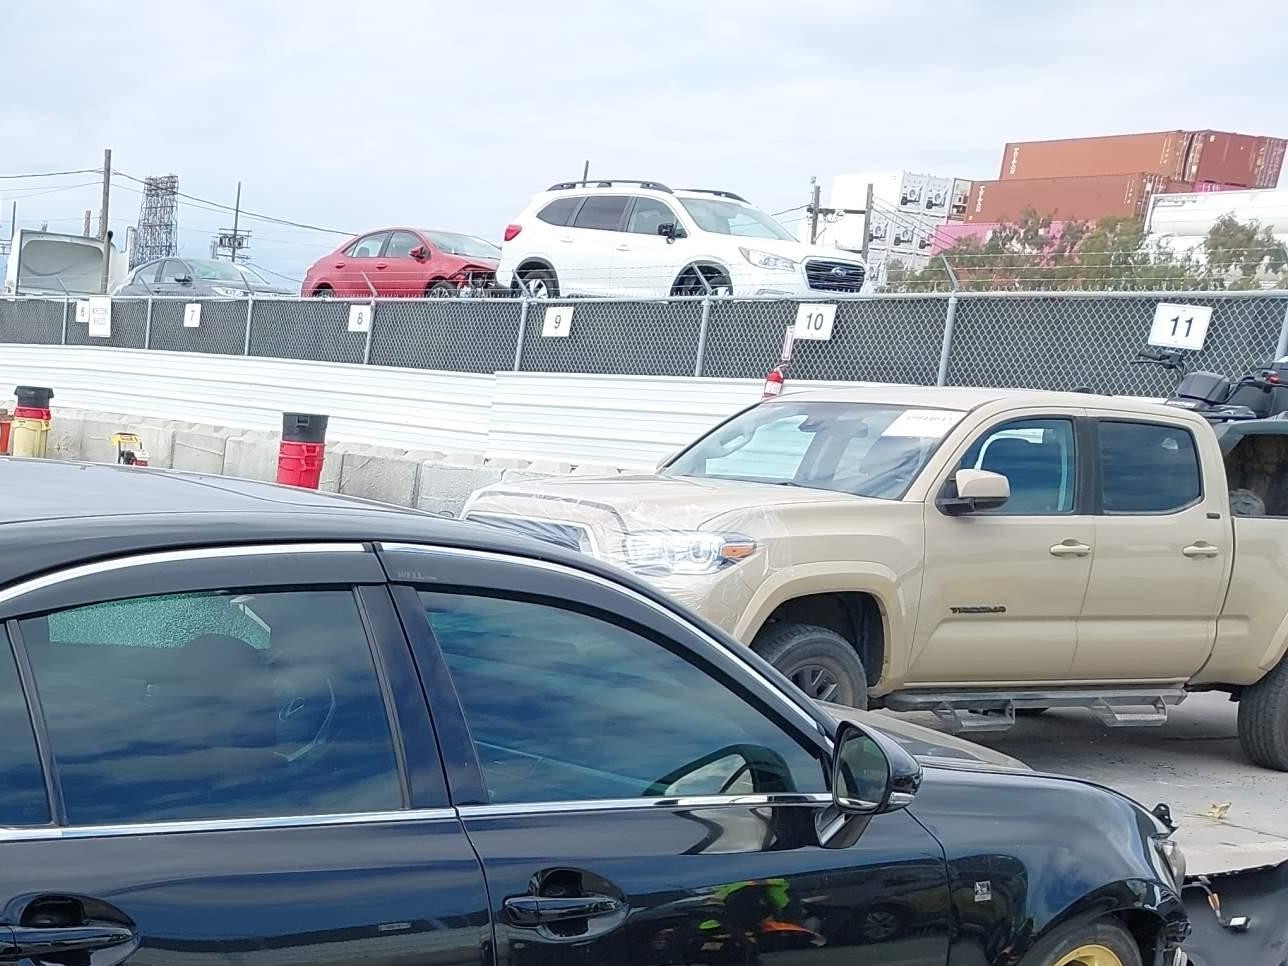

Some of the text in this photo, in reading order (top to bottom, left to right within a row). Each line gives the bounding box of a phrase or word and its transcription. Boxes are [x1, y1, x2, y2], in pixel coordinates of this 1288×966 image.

[357, 312, 363, 325] 8
[554, 314, 561, 329] 9
[806, 312, 824, 331] 10
[1170, 315, 1194, 337] 11
